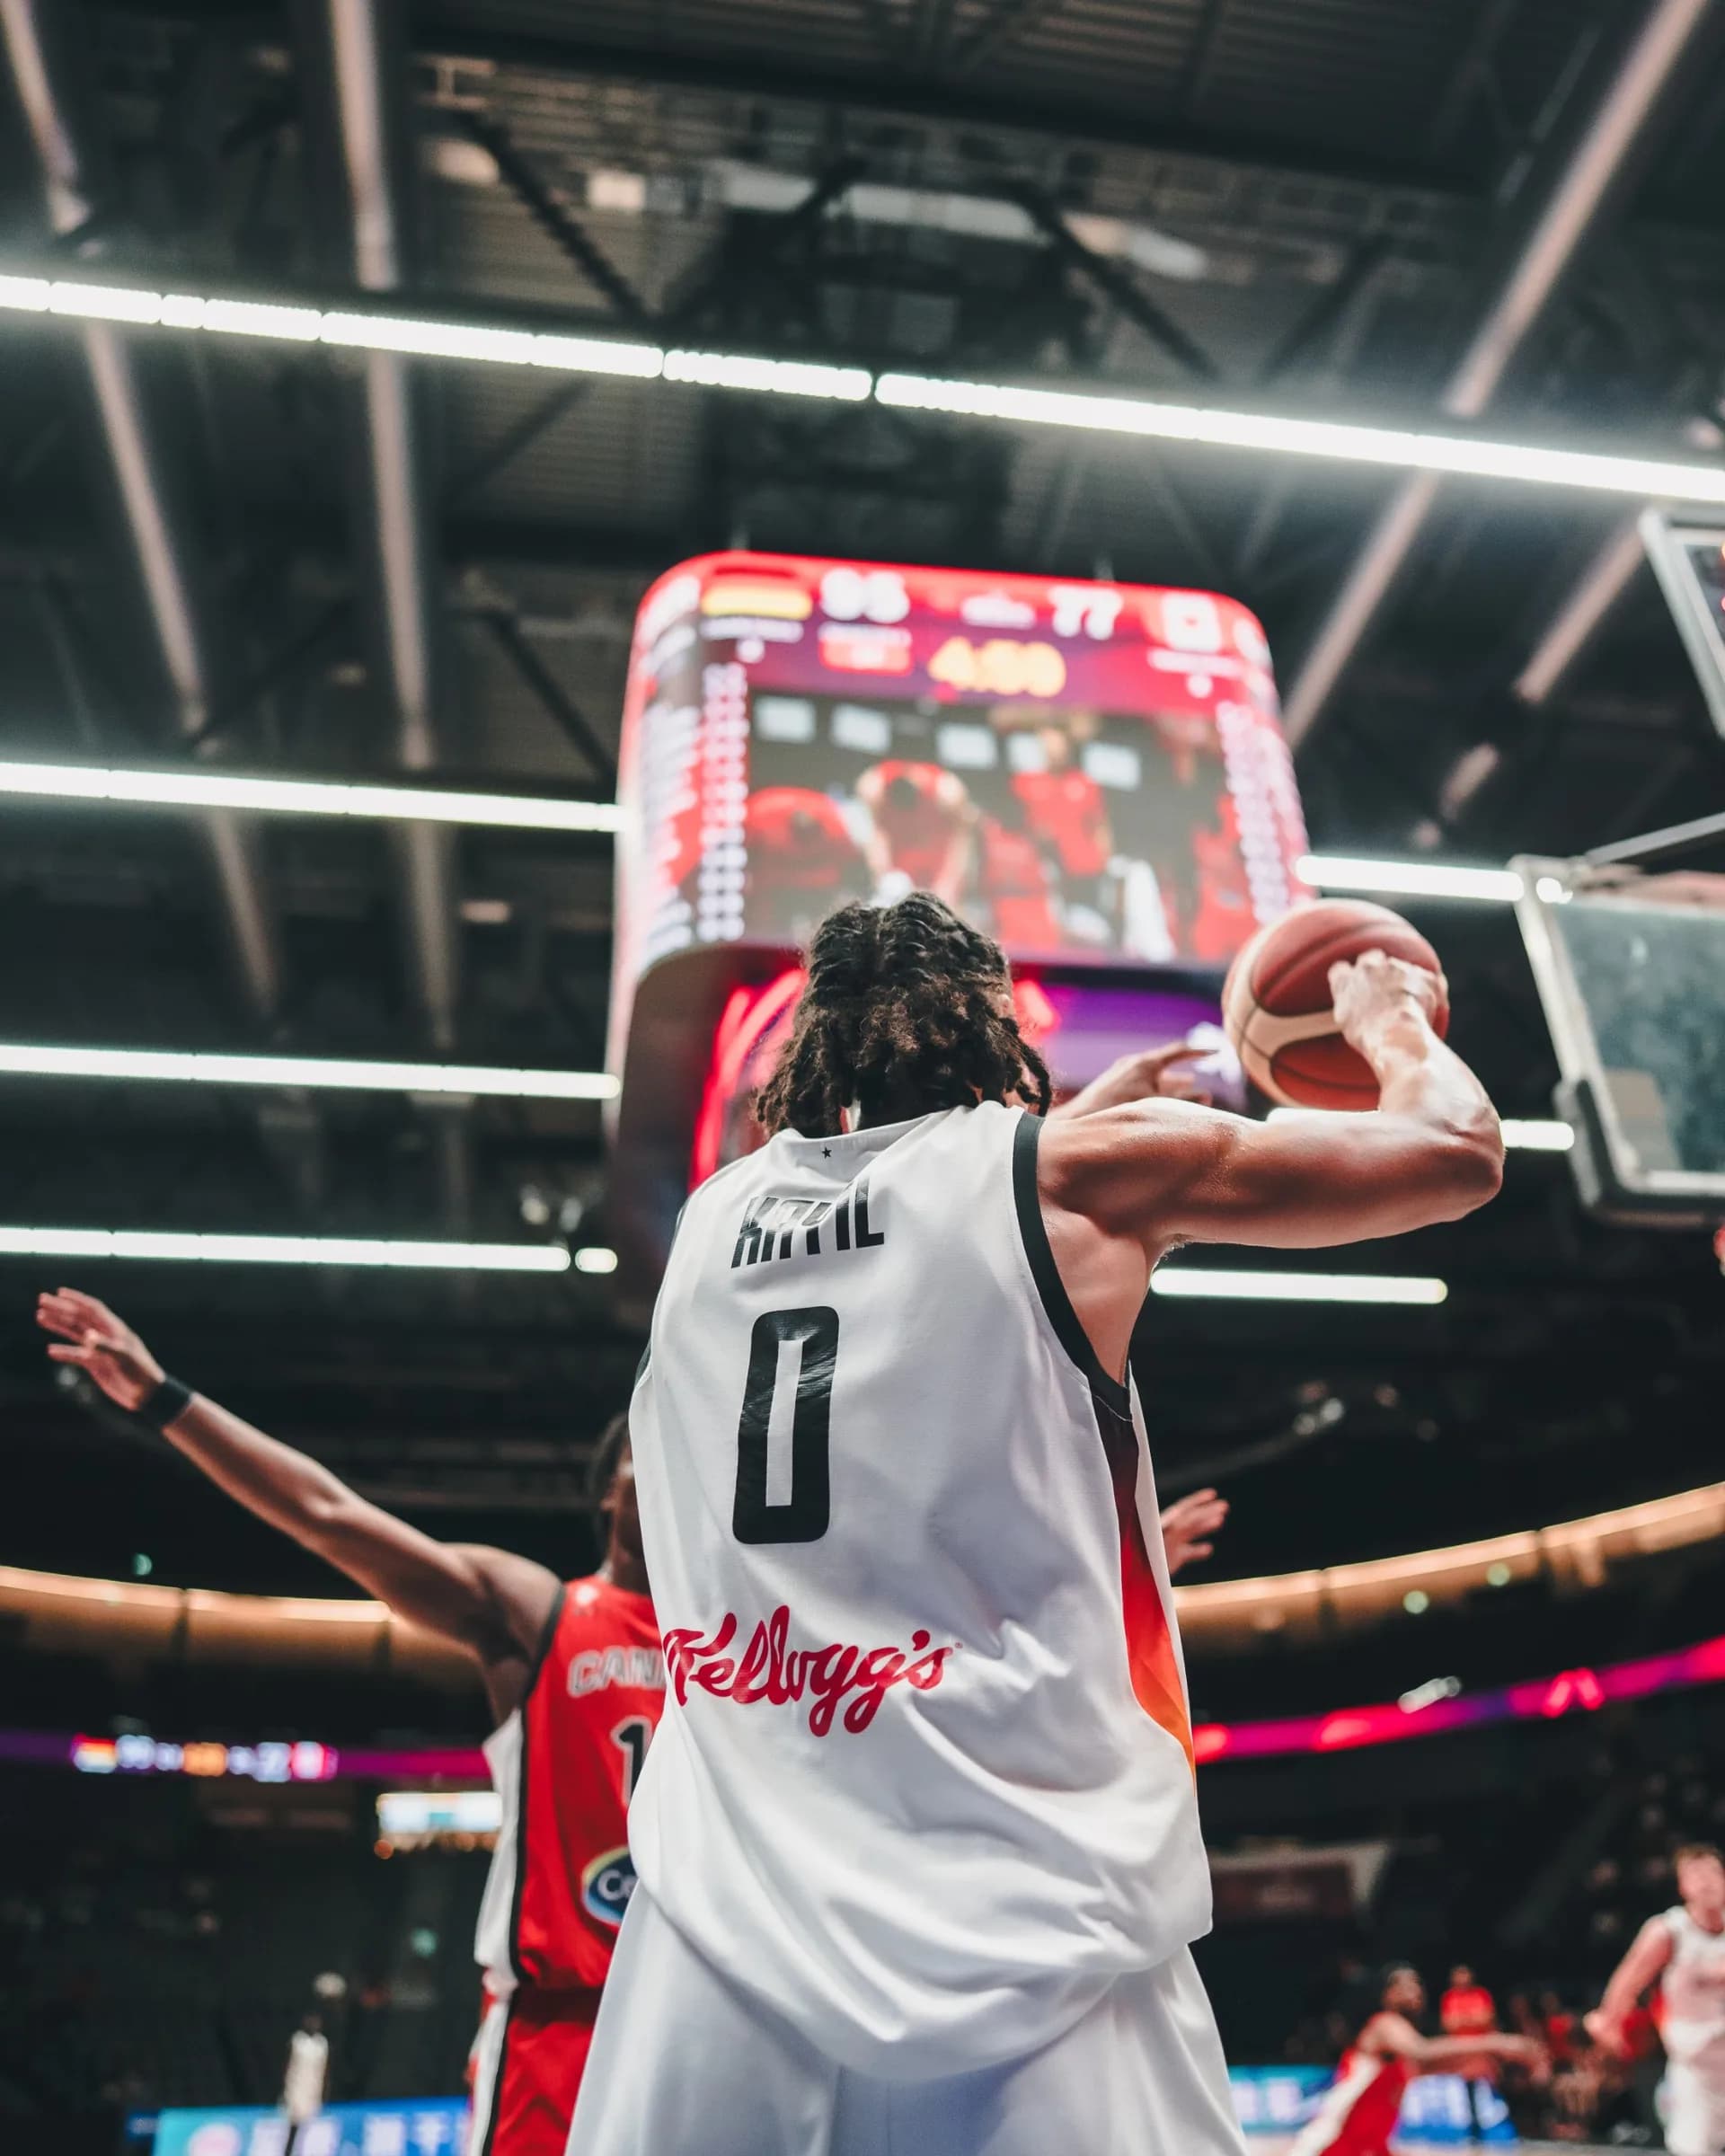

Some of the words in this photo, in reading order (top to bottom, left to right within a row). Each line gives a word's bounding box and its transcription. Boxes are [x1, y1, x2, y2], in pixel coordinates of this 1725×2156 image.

[732, 1305, 839, 1545] 0
[567, 1646, 668, 1698] CAN
[663, 1604, 953, 1737] Kellogg's
[611, 1714, 655, 1810] 1
